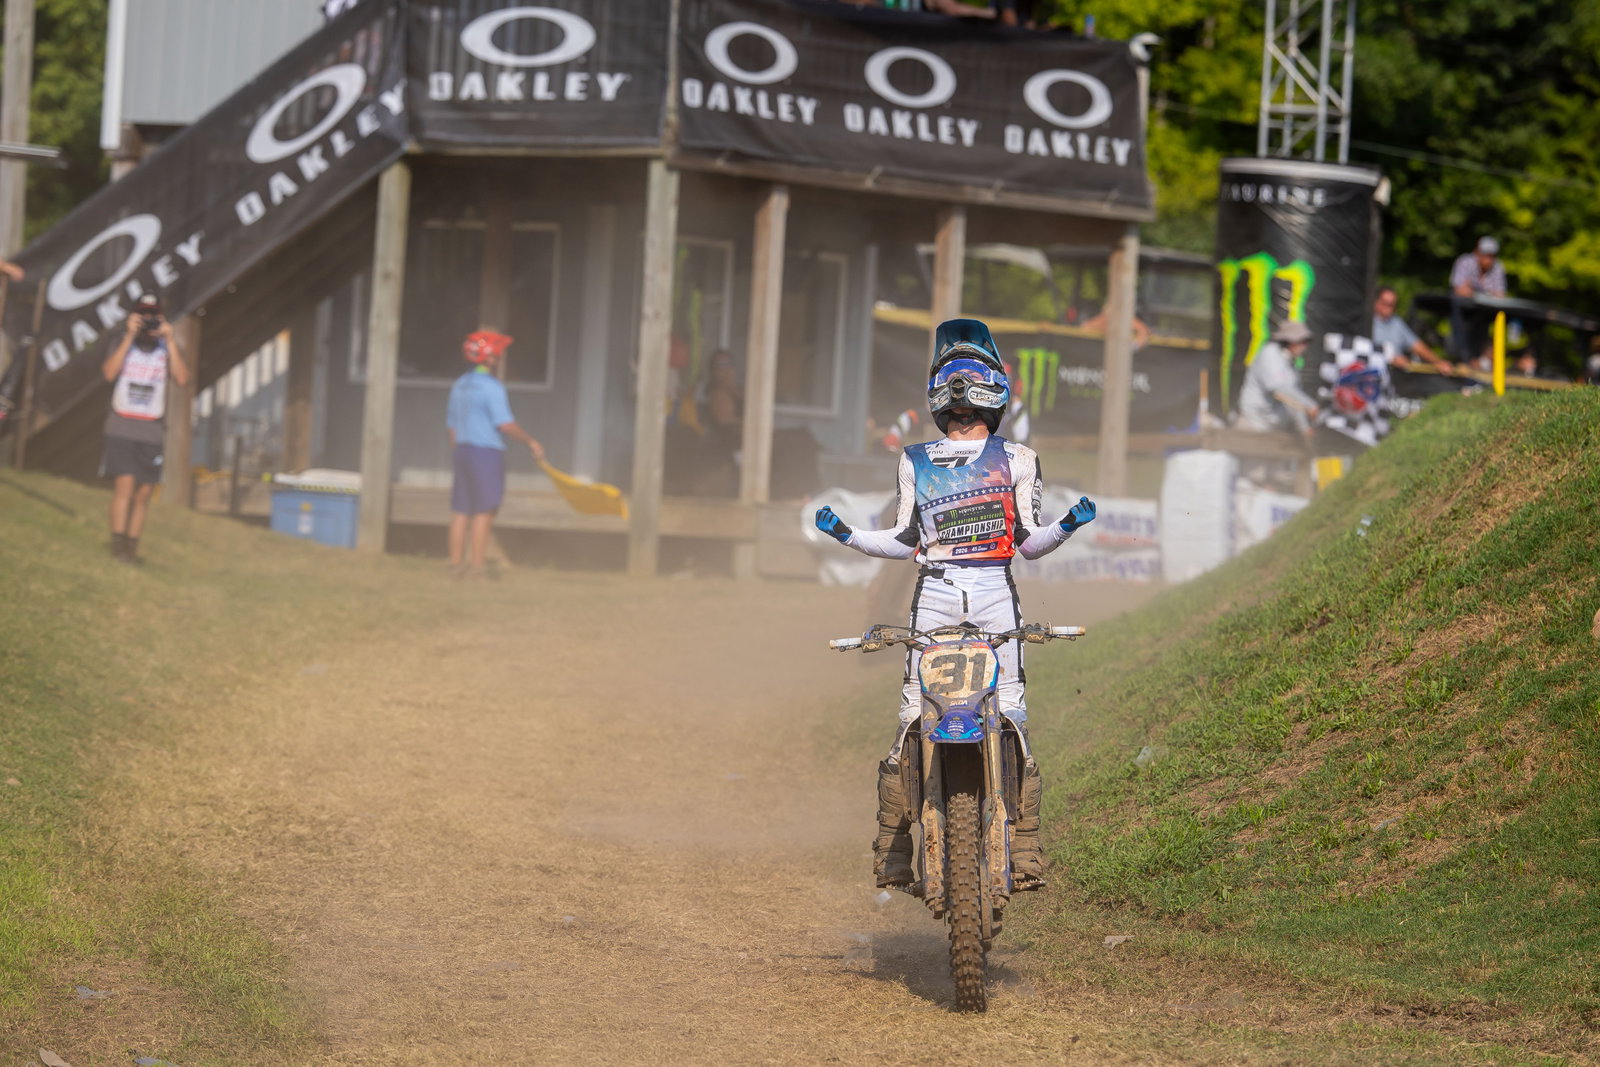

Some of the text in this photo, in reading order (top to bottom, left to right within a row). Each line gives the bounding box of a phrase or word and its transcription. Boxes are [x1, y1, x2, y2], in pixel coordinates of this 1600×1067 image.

[428, 71, 628, 101] OAKLEY
[682, 78, 818, 126] OAKLEY
[843, 103, 978, 148] OAKLEY
[1004, 124, 1132, 167] OAKLEY
[234, 79, 407, 227] OAKLEY
[42, 229, 205, 373] OAKLEY
[940, 520, 1004, 539] CHAMPIONSHIP
[928, 652, 987, 694] 31
